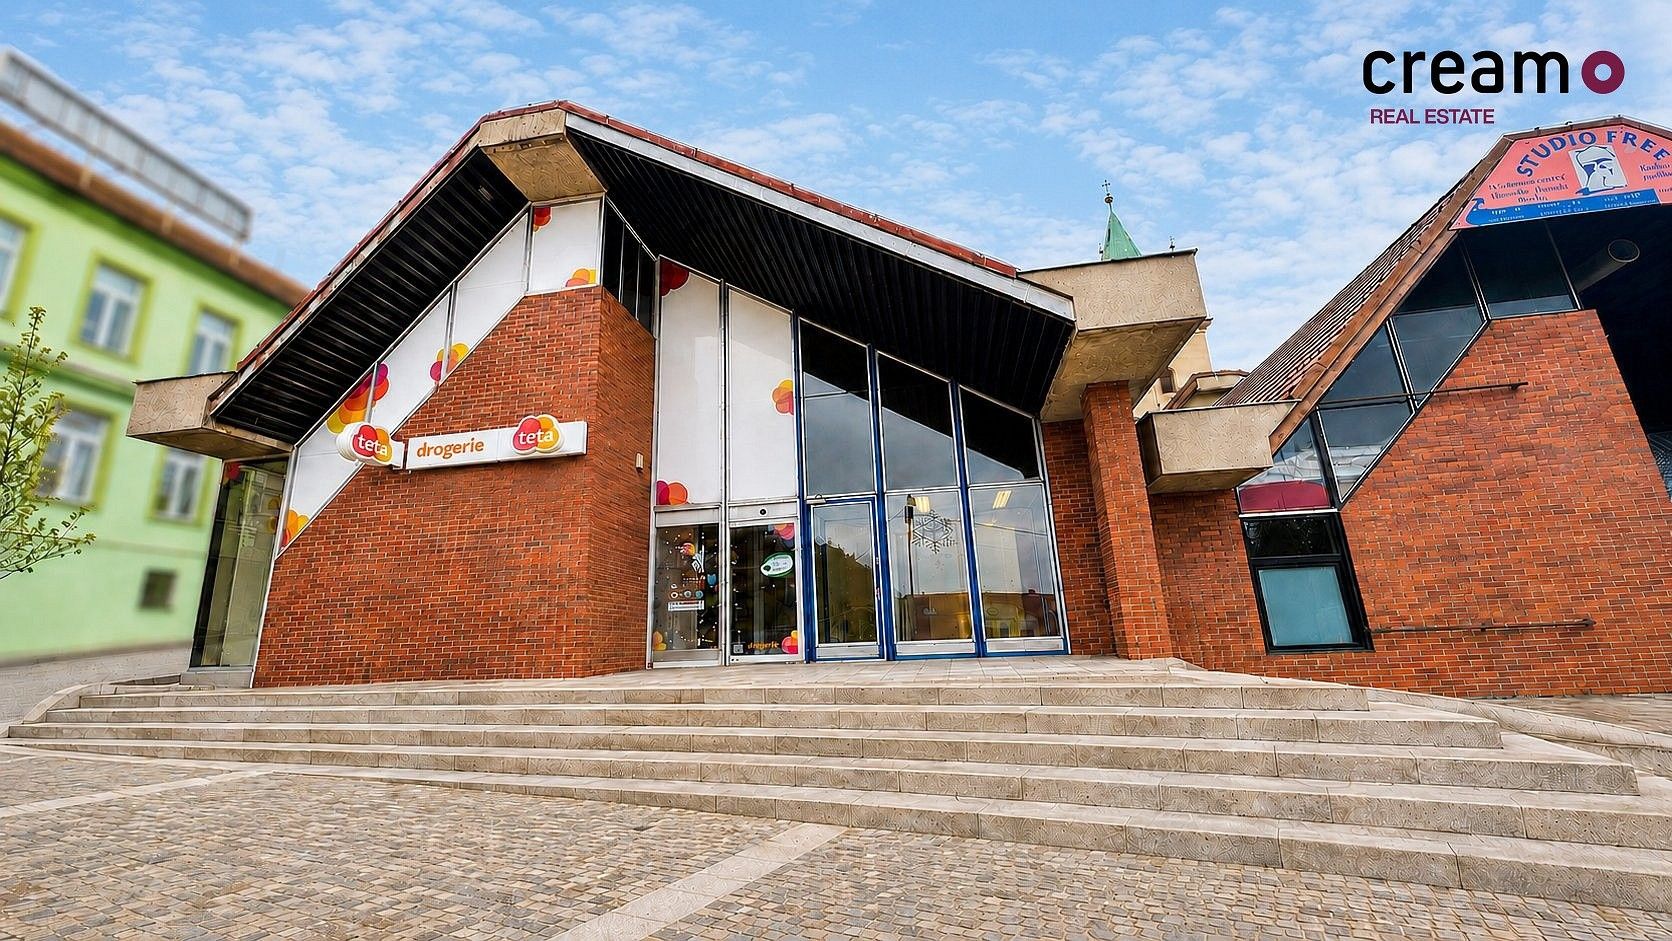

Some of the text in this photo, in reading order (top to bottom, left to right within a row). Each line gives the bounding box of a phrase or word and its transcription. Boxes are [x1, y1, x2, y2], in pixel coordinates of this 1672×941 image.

[1516, 130, 1671, 177] STUDIO FREE
[357, 434, 388, 456] teta
[416, 430, 554, 461] drogerie teta
